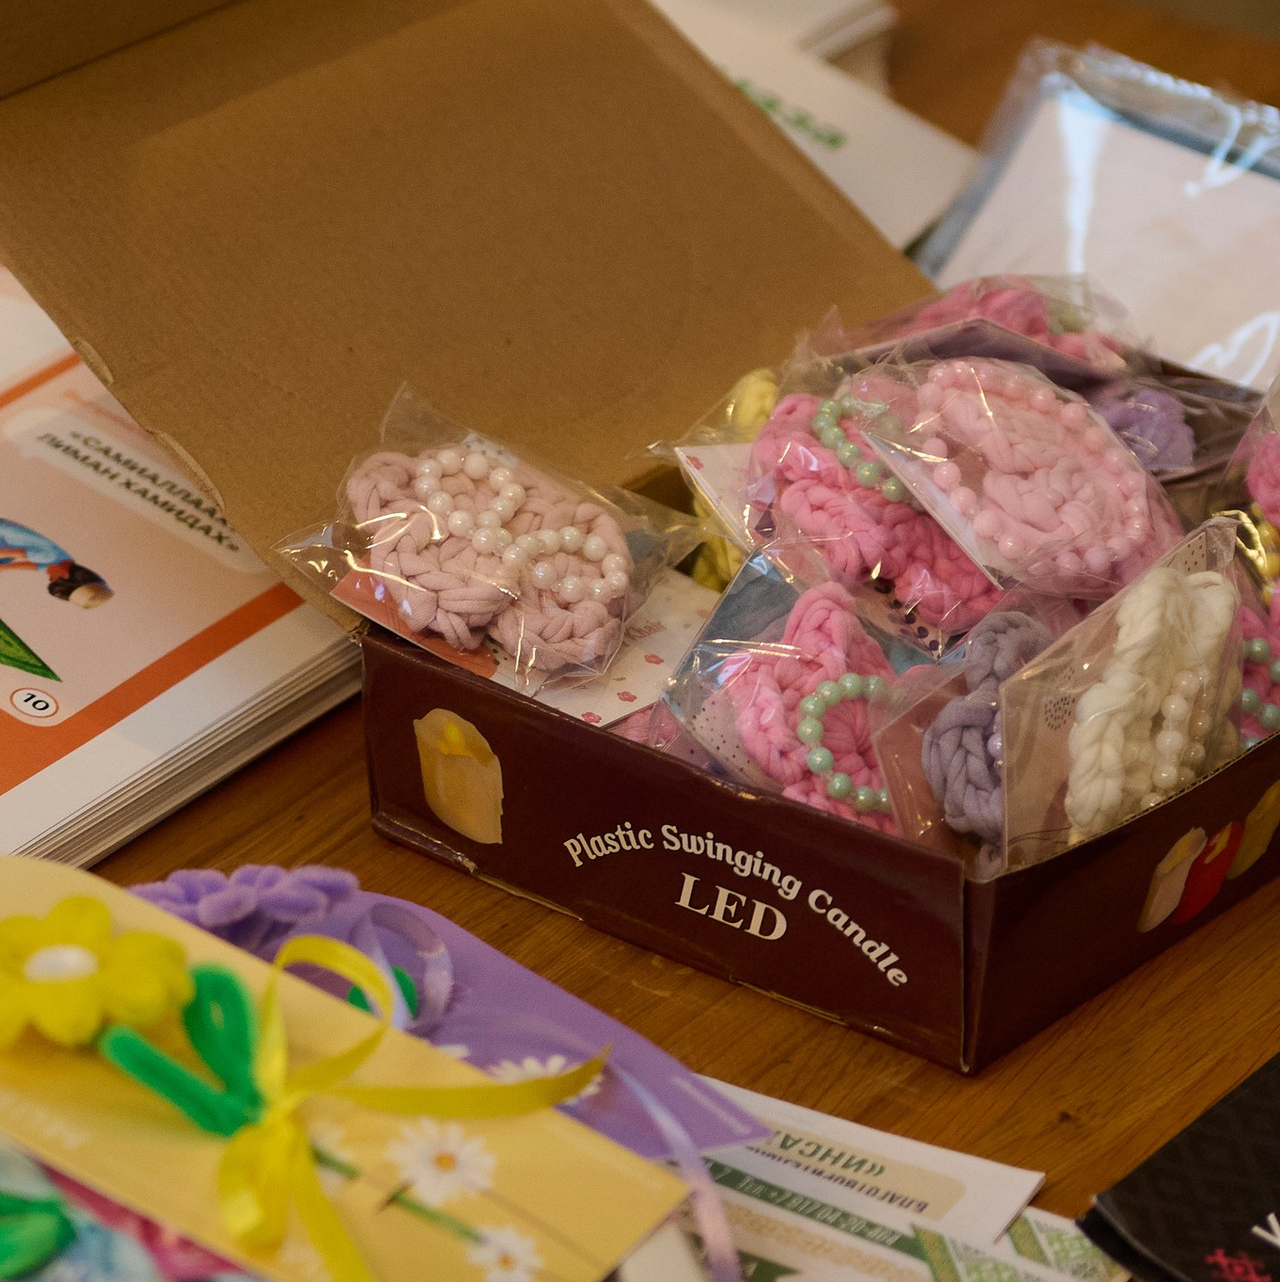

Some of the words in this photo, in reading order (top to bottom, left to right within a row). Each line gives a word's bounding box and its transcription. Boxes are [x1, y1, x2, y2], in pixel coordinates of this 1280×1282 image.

[23, 692, 51, 713] 10
[563, 821, 655, 867] Plastic
[660, 823, 803, 901] Swinging
[807, 888, 909, 987] Candle
[674, 871, 788, 941] LED
[773, 1129, 887, 1178] «ИНСА
